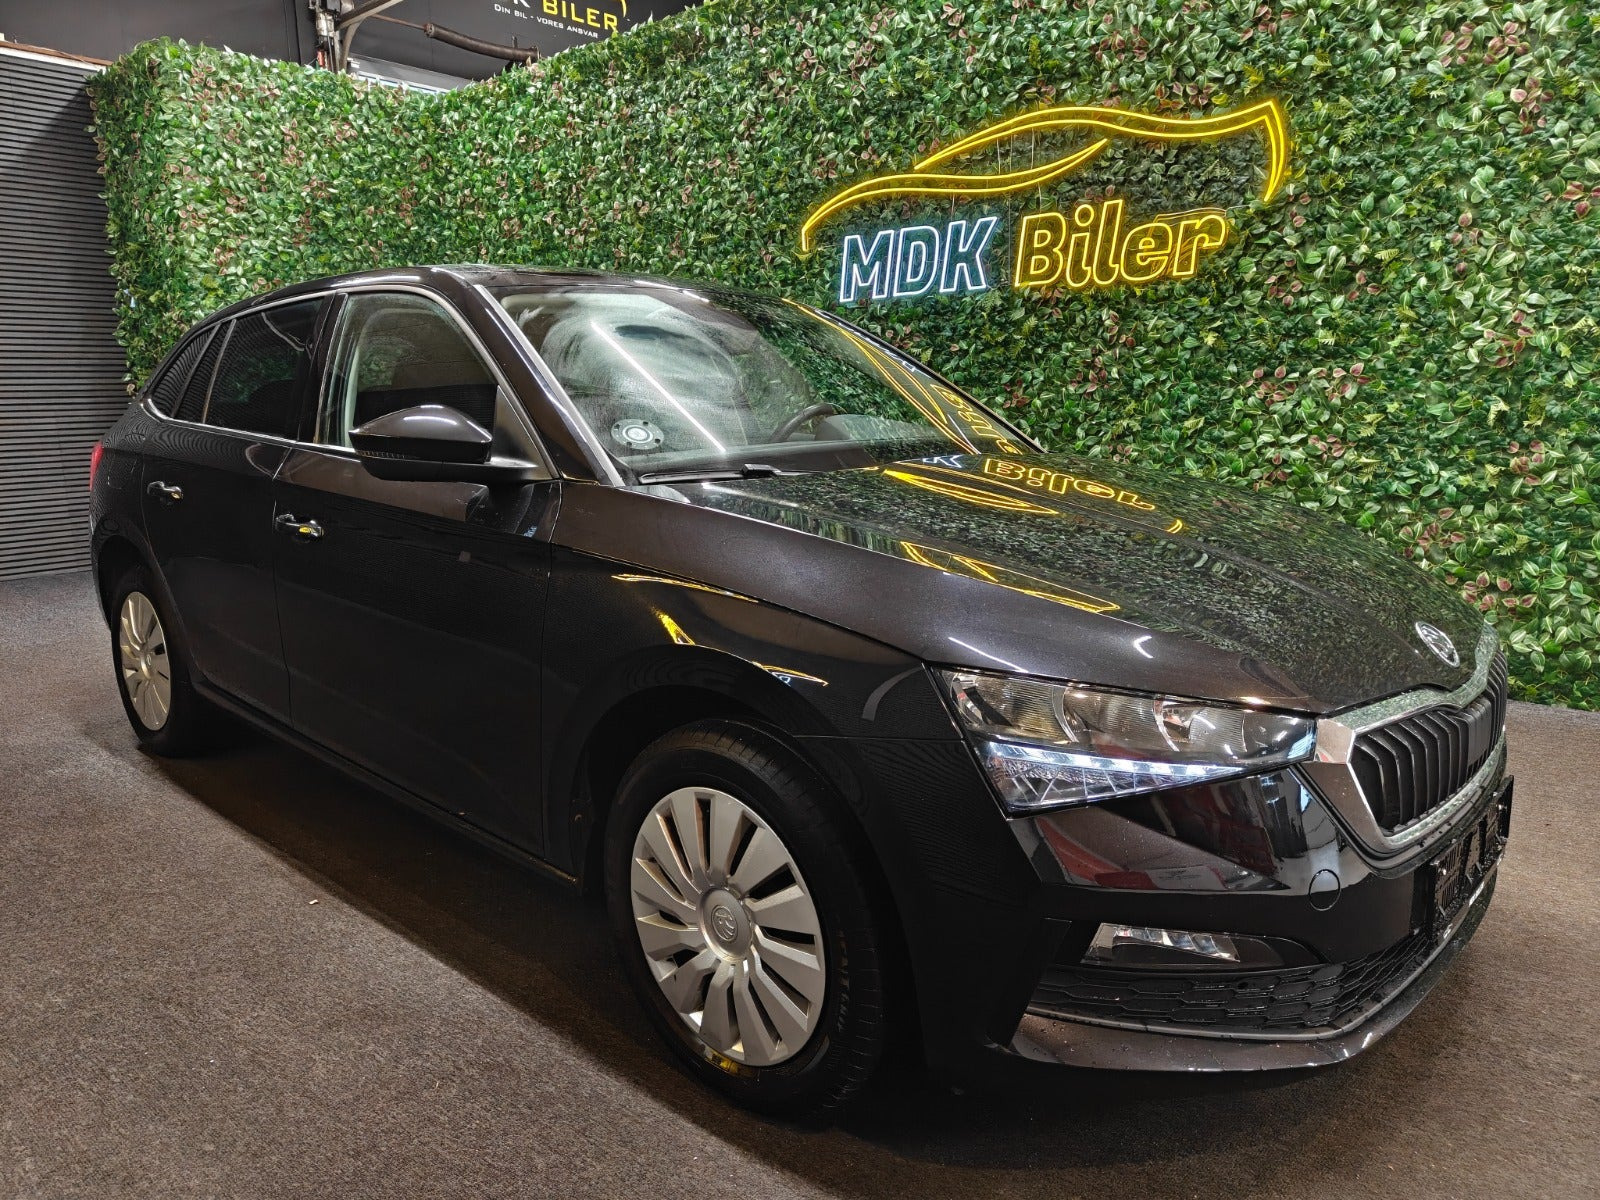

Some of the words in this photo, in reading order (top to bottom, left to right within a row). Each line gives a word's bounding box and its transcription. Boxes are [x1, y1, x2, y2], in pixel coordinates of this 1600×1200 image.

[494, 3, 511, 15] DIN
[514, 9, 528, 20] BIL
[536, 16, 563, 29] VORES
[566, 25, 598, 38] ANSVAR
[542, 0, 618, 32] BILER
[839, 216, 998, 303] MDK
[1014, 199, 1227, 288] Biler
